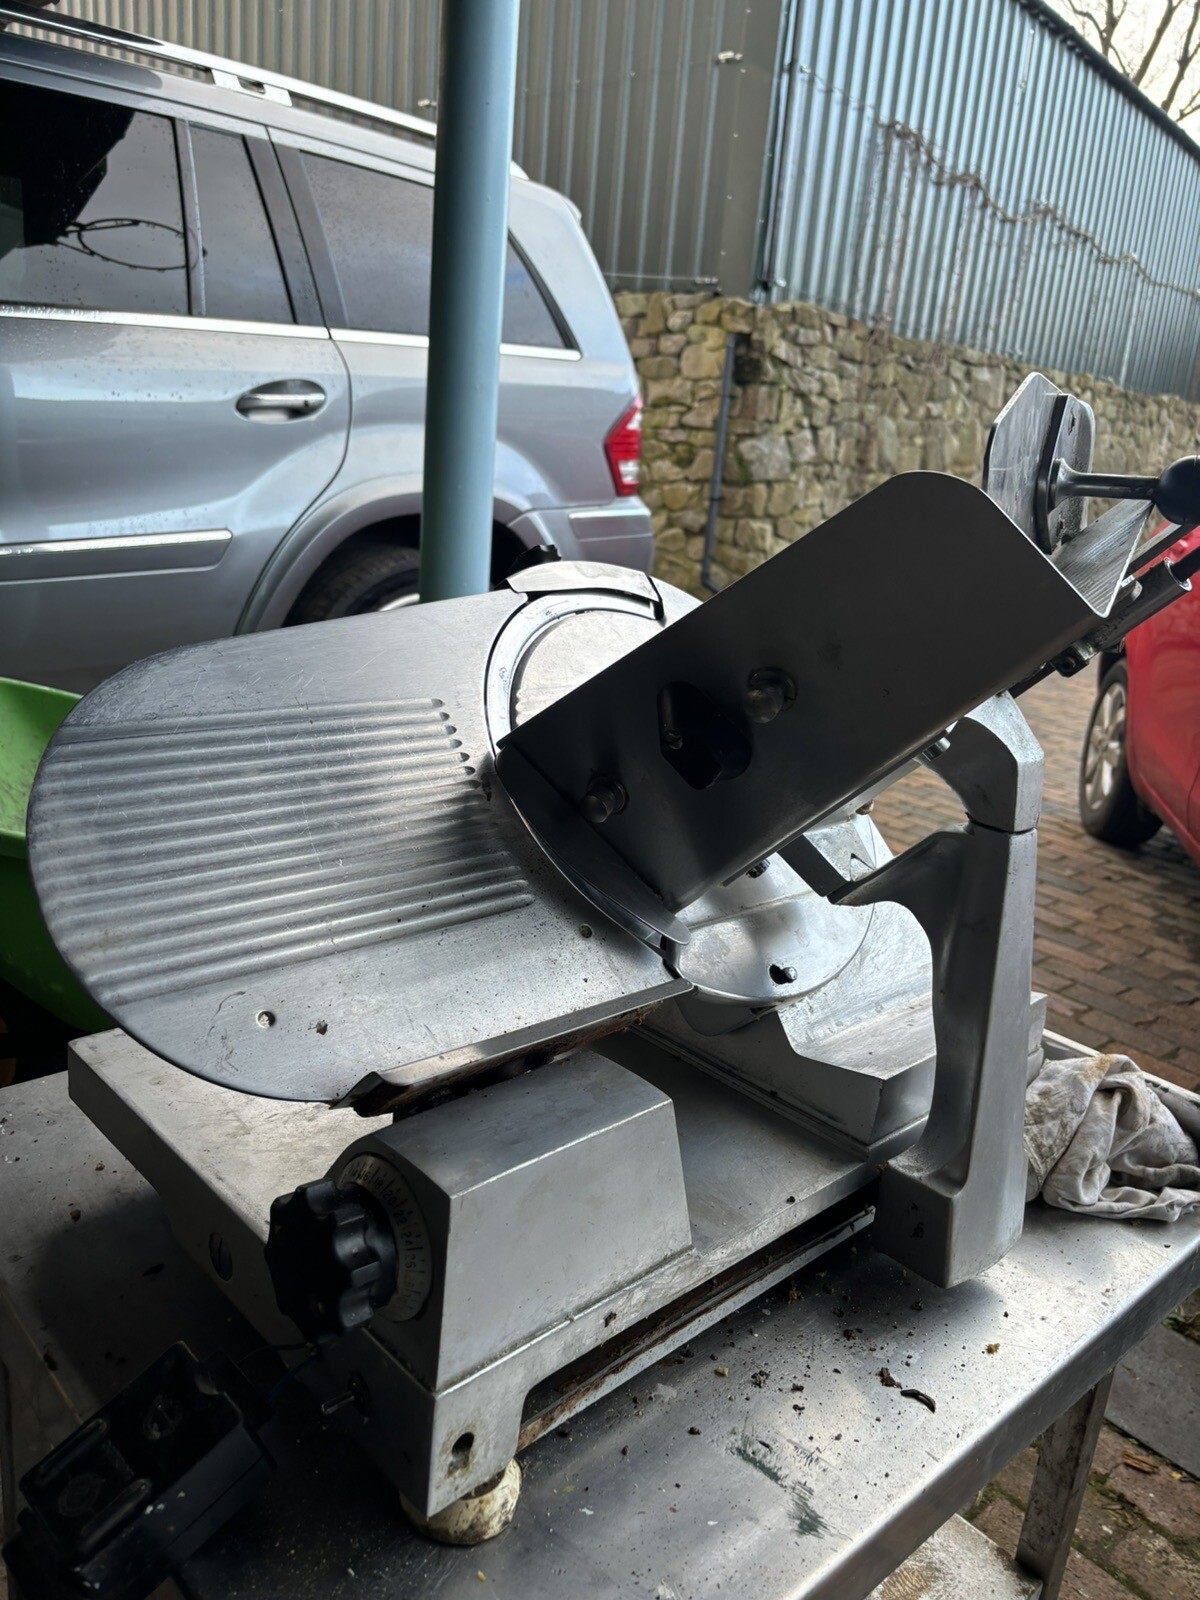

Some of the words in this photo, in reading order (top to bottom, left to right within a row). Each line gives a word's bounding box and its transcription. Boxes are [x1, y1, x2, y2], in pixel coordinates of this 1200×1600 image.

[374, 1177, 384, 1190] 18
[383, 1190, 398, 1205] 20
[393, 1210, 408, 1226] 22
